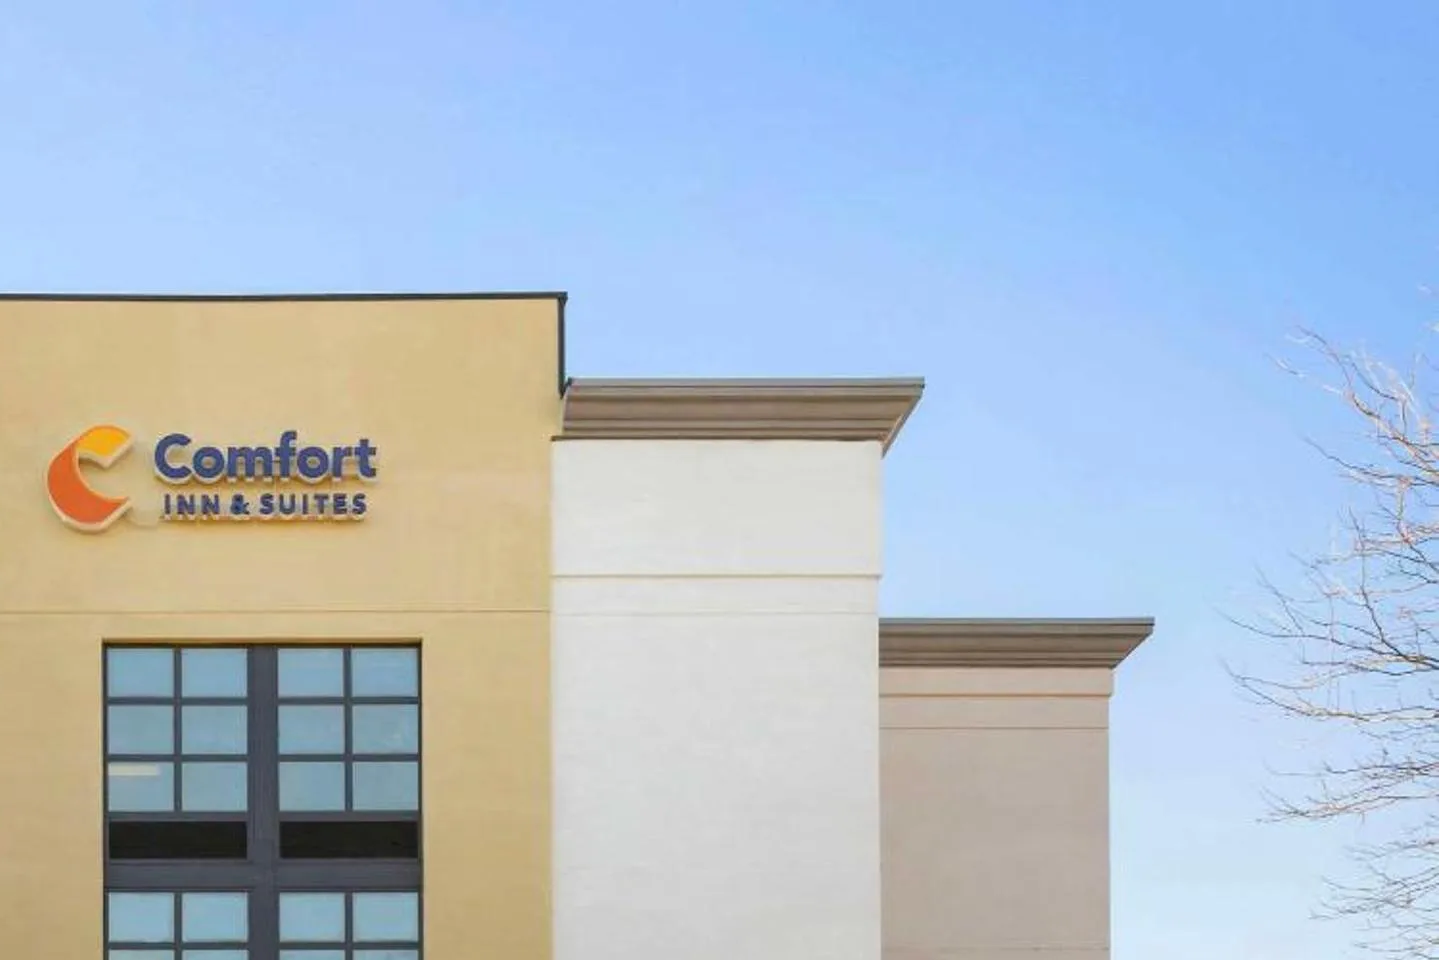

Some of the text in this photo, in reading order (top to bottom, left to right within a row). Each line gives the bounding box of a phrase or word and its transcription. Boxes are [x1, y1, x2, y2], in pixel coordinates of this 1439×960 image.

[154, 430, 377, 479] Comfort
[164, 493, 367, 515] INN & SUITES
